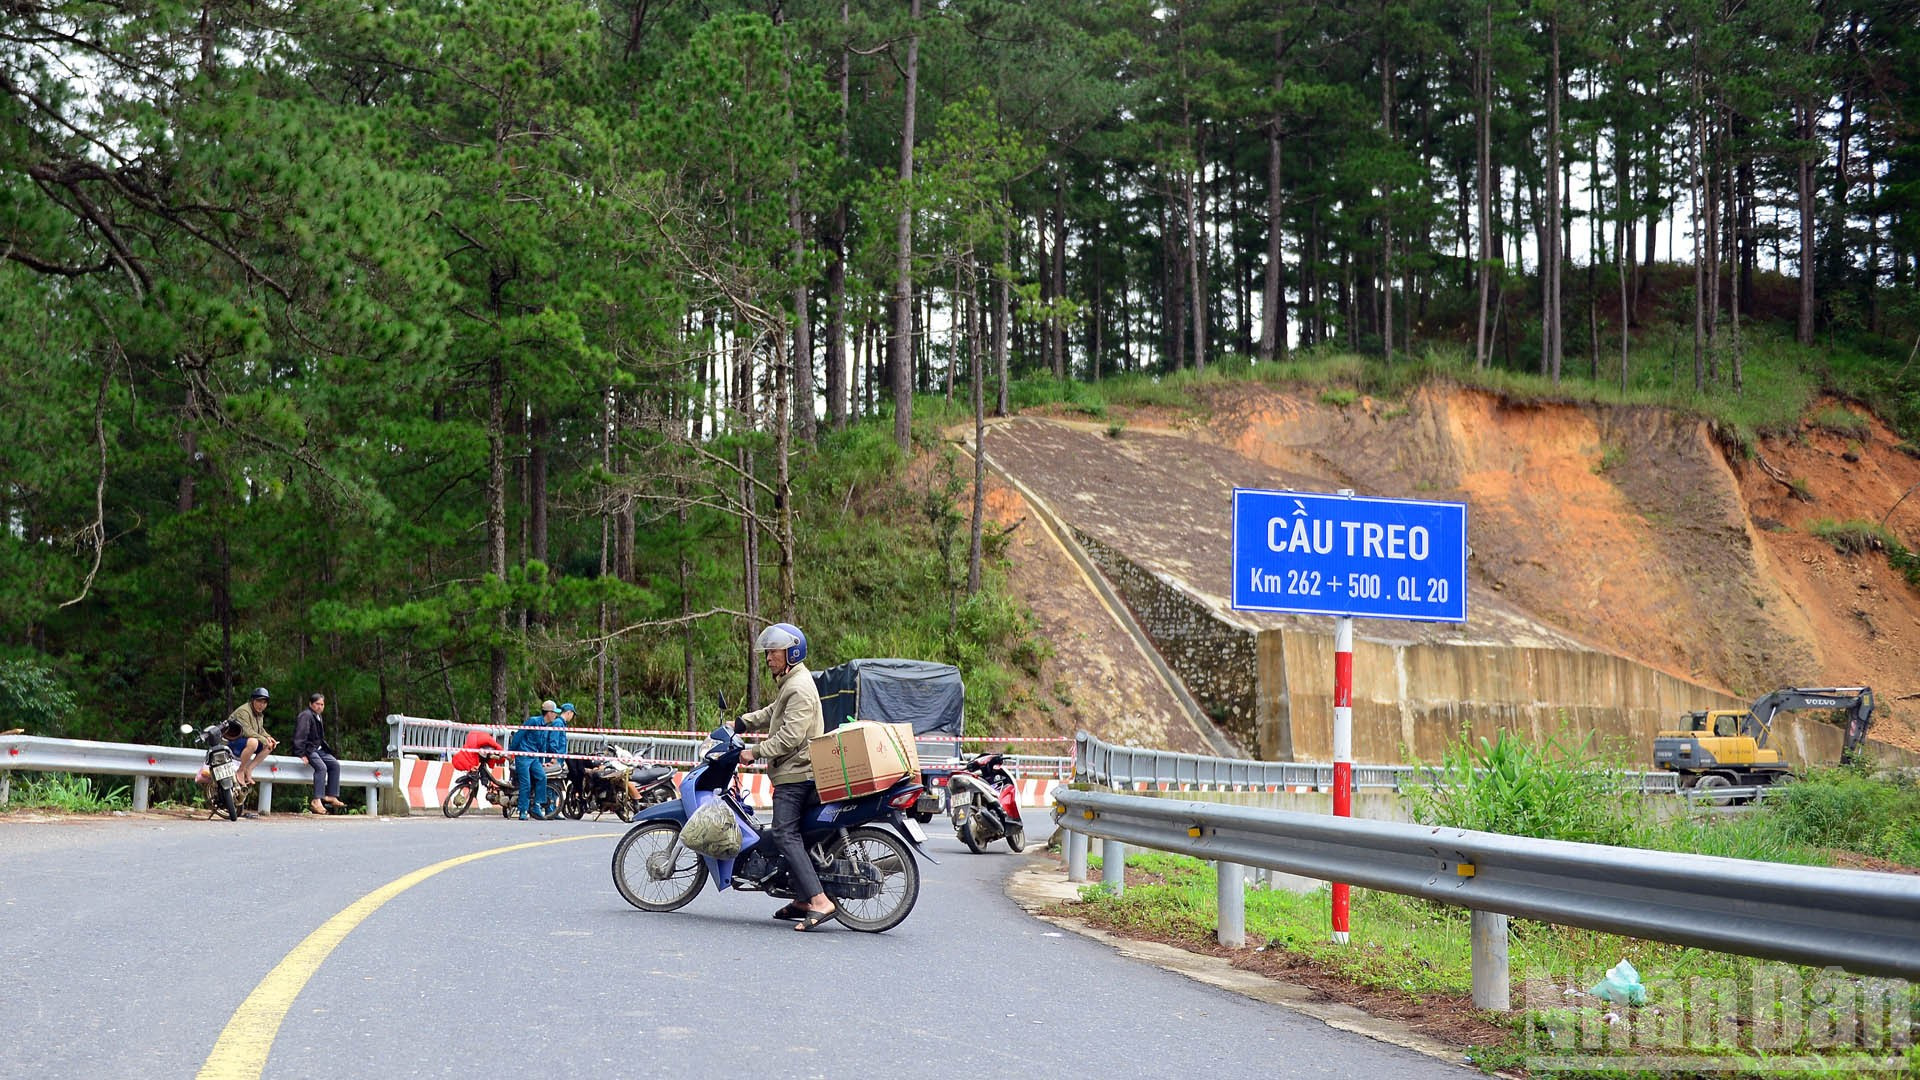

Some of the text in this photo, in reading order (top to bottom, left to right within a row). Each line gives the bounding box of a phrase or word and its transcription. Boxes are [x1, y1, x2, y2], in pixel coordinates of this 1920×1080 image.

[1267, 500, 1429, 561] CẦU TREO
[1250, 567, 1281, 594] Km
[1287, 569, 1321, 596] 262
[1326, 575, 1343, 592] +
[1348, 573, 1381, 599] 500
[1397, 576, 1421, 602] QL
[1427, 578, 1448, 603] 20
[1805, 698, 1836, 706] VOLVO
